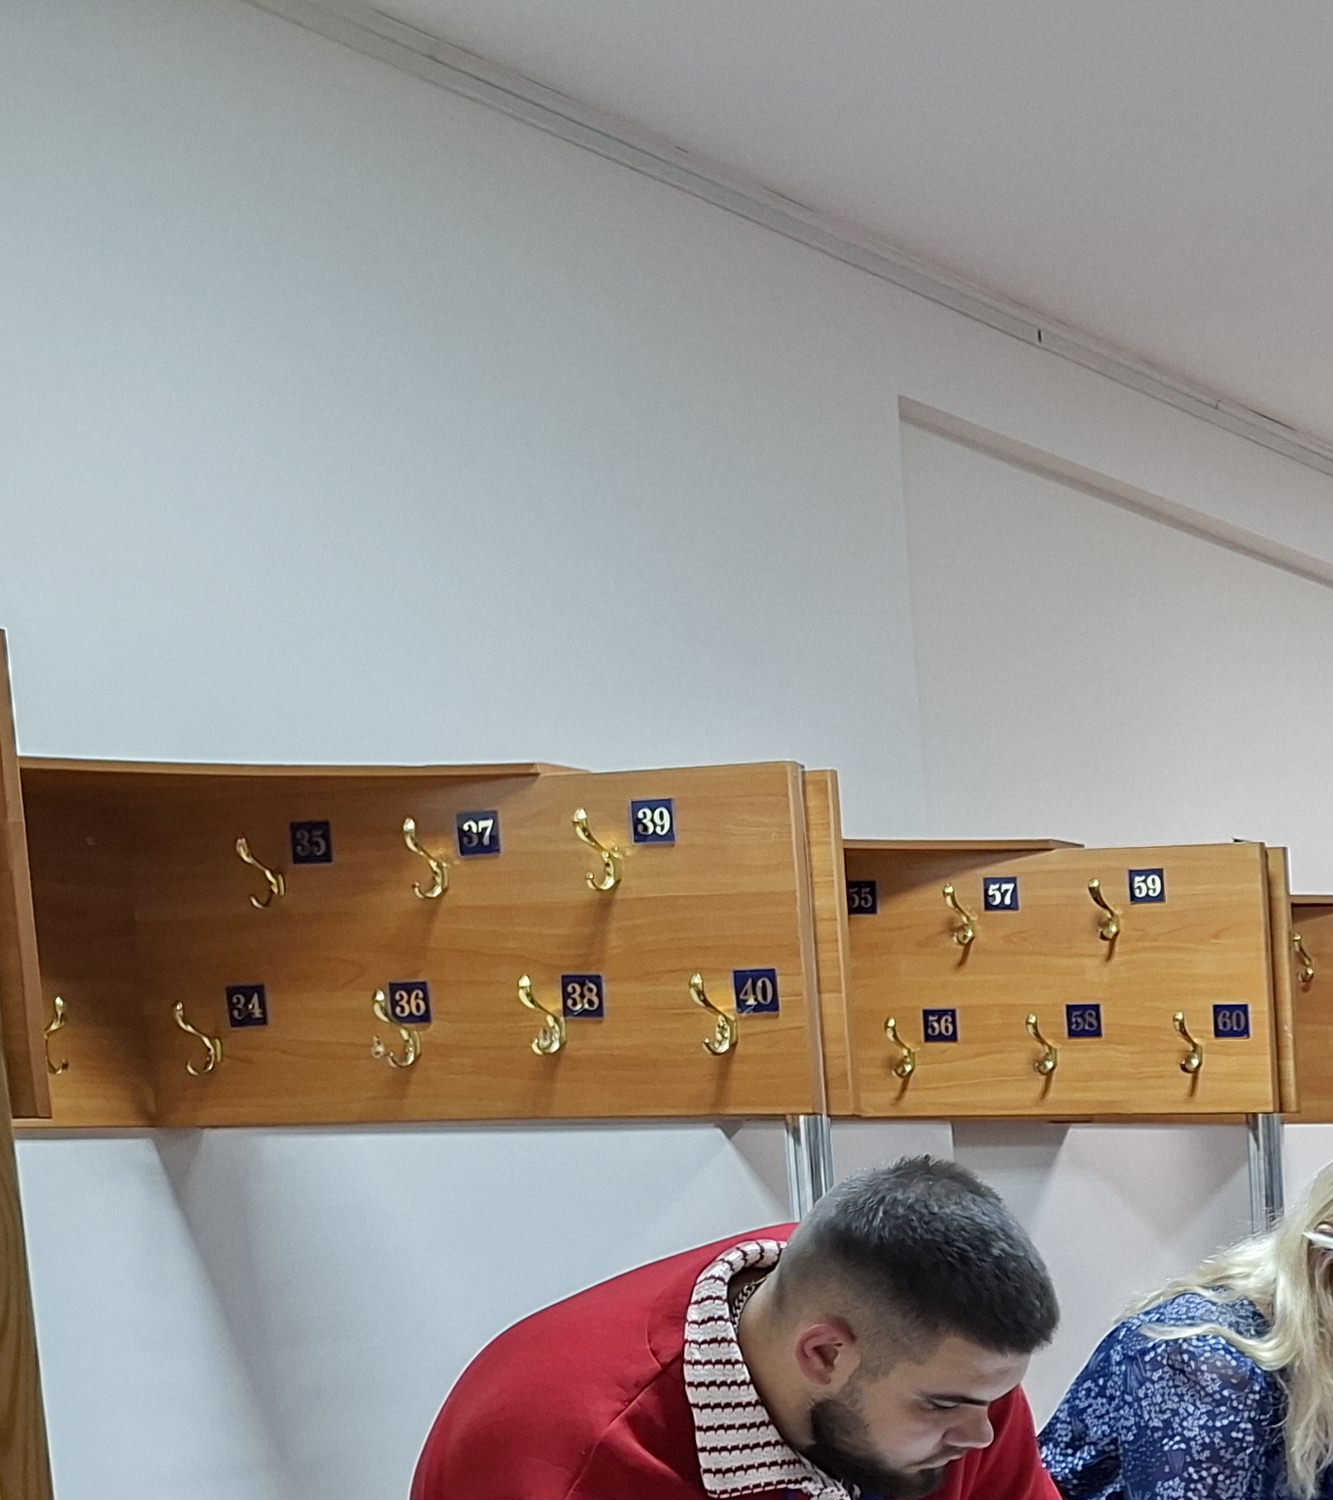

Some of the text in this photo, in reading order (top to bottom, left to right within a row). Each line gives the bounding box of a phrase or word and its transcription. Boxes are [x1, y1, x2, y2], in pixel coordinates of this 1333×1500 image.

[463, 819, 494, 847] 37
[637, 806, 671, 835] 39
[295, 830, 327, 856] 35
[849, 887, 873, 908] 55
[988, 883, 1015, 906] 57
[1133, 875, 1162, 898] 59
[394, 989, 426, 1017] 36
[566, 982, 600, 1011] 38
[740, 977, 773, 1005] 40
[232, 992, 264, 1020] 34
[927, 1015, 953, 1036] 56
[1071, 1009, 1098, 1032] 58
[1217, 1010, 1246, 1031] 60
